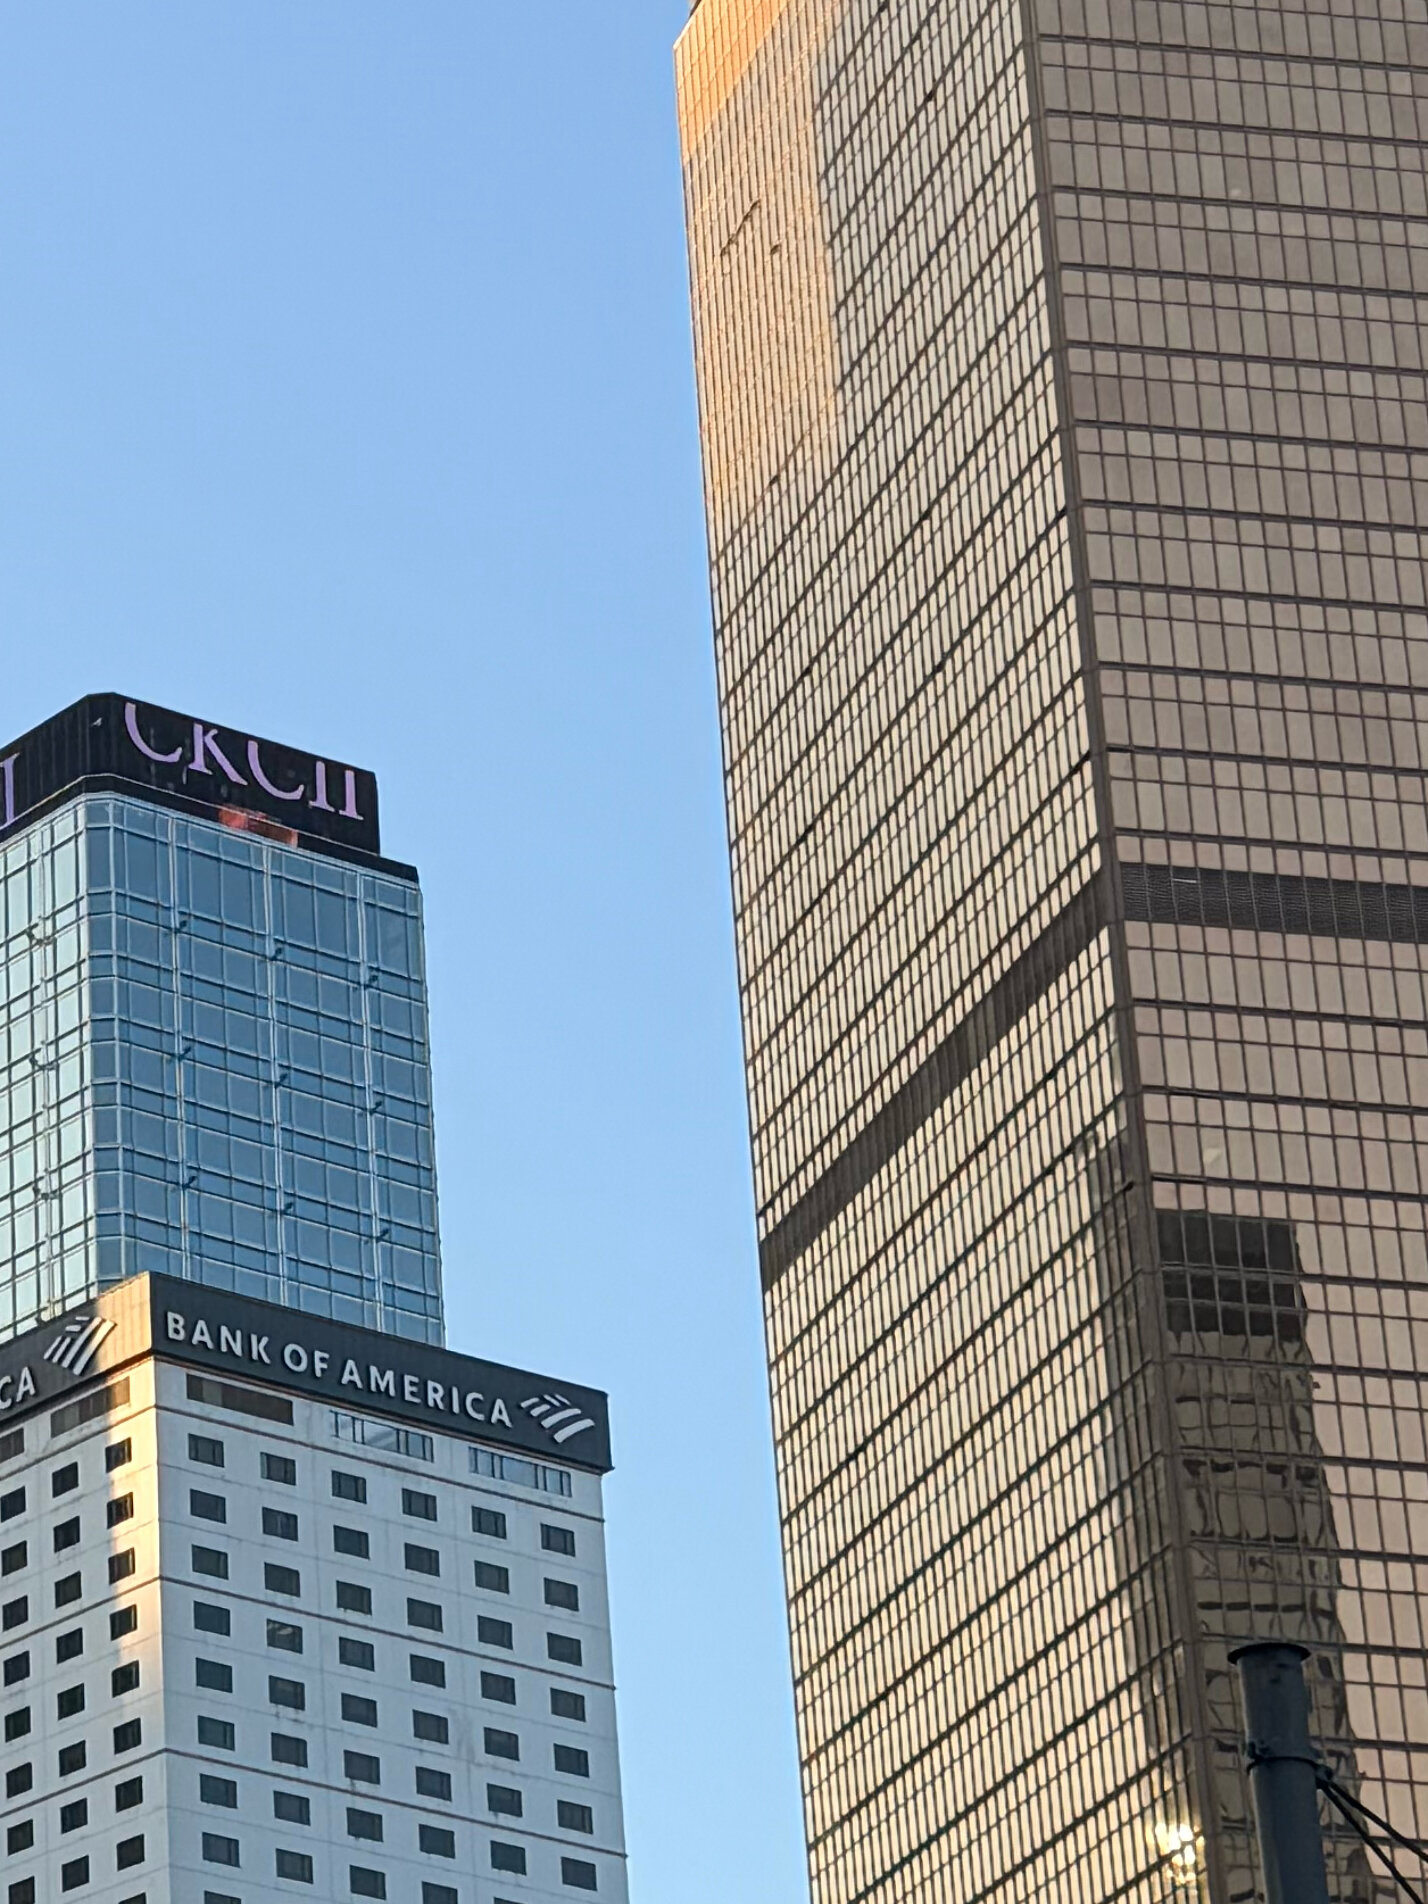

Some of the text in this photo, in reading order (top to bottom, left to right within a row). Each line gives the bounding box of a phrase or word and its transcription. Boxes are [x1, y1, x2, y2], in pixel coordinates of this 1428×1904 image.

[166, 1310, 513, 1429] BANK OF AMERICA
